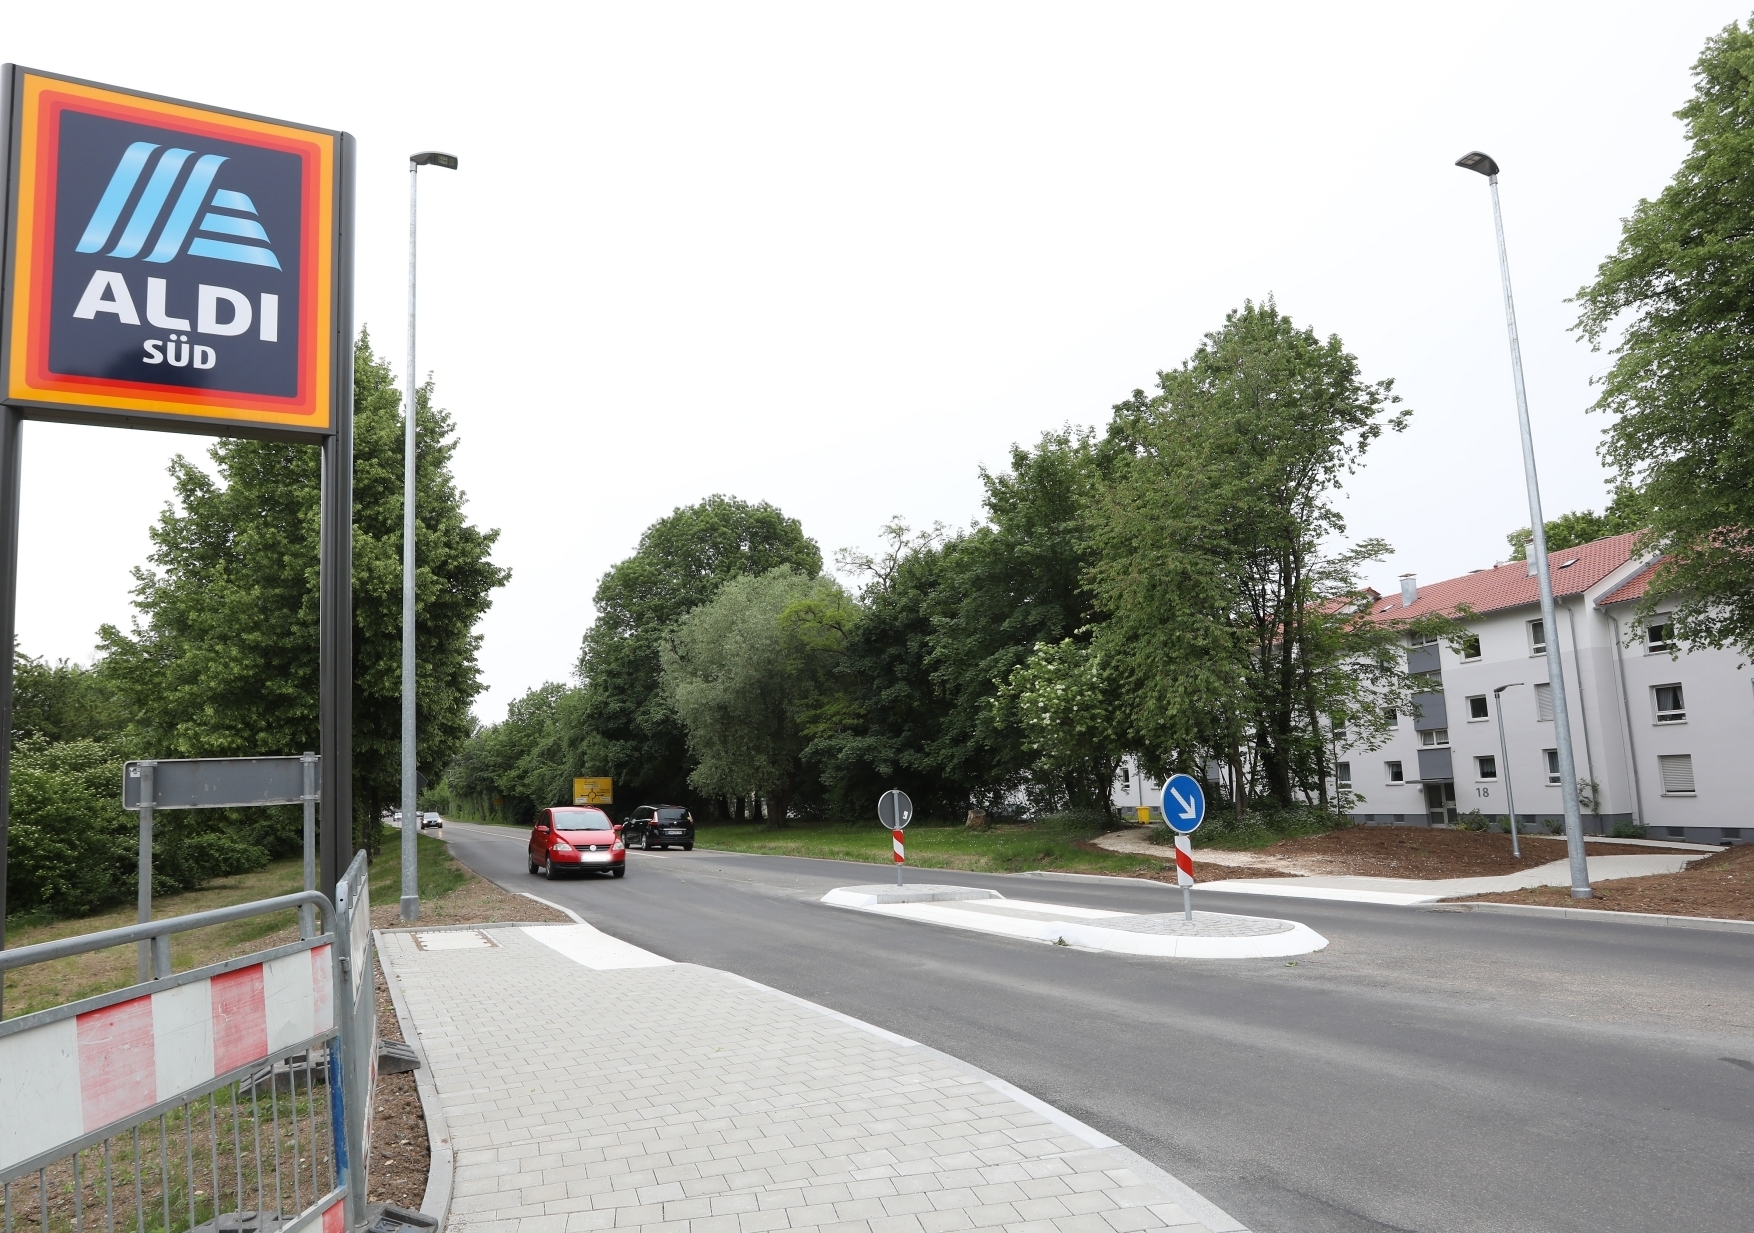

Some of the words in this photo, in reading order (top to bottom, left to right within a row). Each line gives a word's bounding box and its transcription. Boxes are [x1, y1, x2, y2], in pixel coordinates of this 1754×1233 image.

[73, 269, 279, 343] ALDI
[142, 333, 217, 370] SÜD
[1475, 787, 1490, 798] 18
